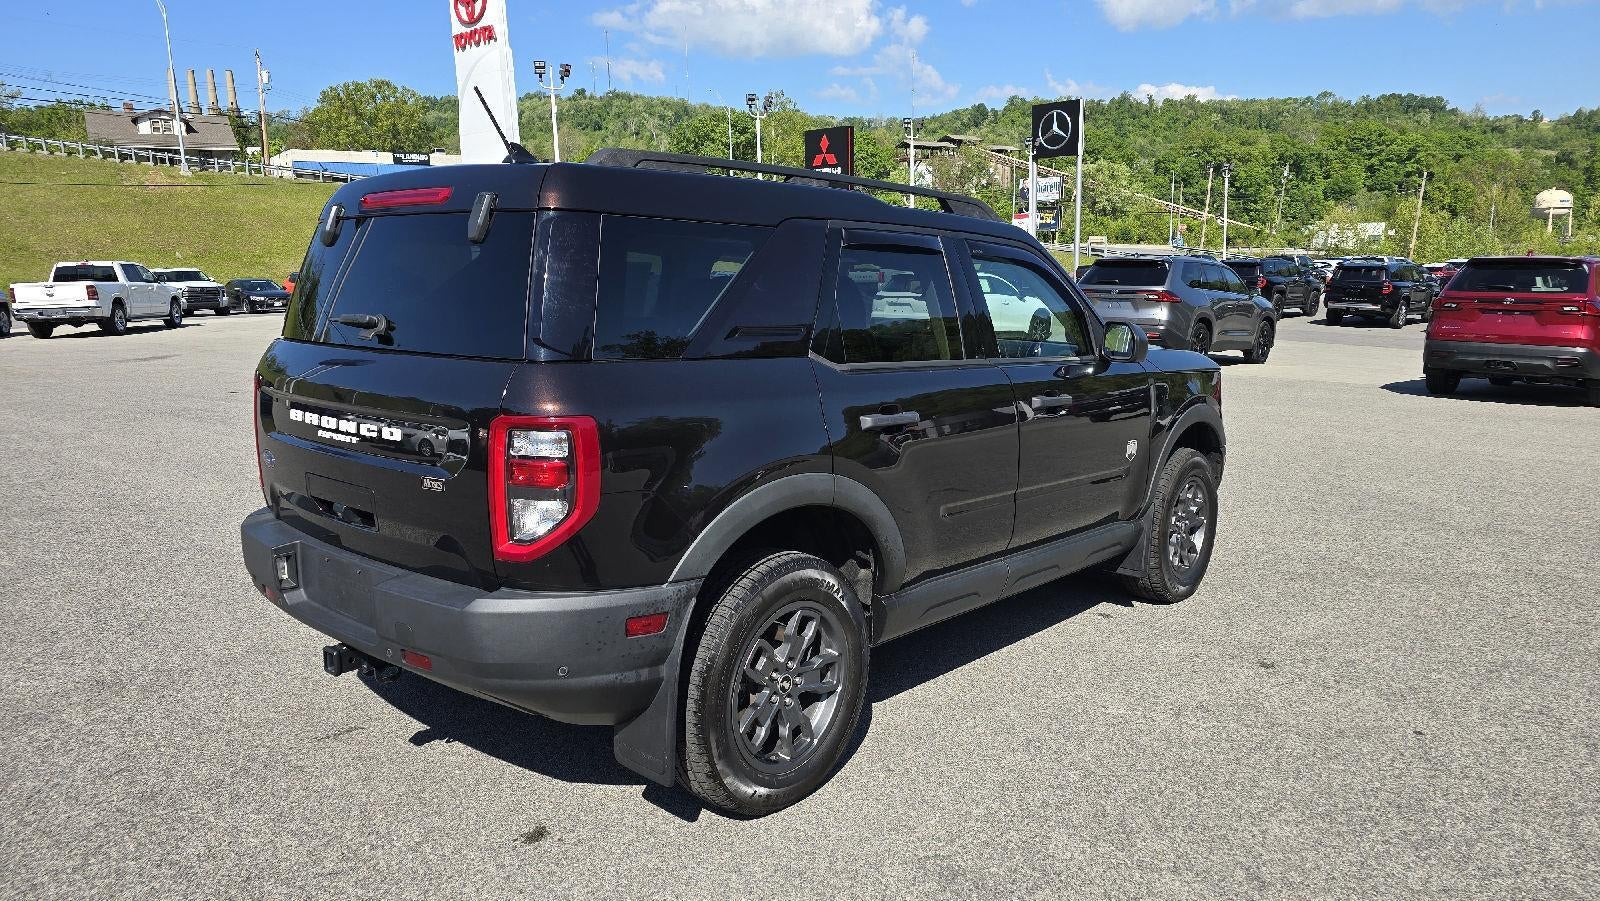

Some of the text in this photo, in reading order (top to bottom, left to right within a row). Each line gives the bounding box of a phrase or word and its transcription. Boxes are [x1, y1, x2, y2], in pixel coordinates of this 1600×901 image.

[453, 25, 496, 52] TOYOTA
[289, 408, 402, 442] BRONCO
[317, 429, 361, 444] SPORT
